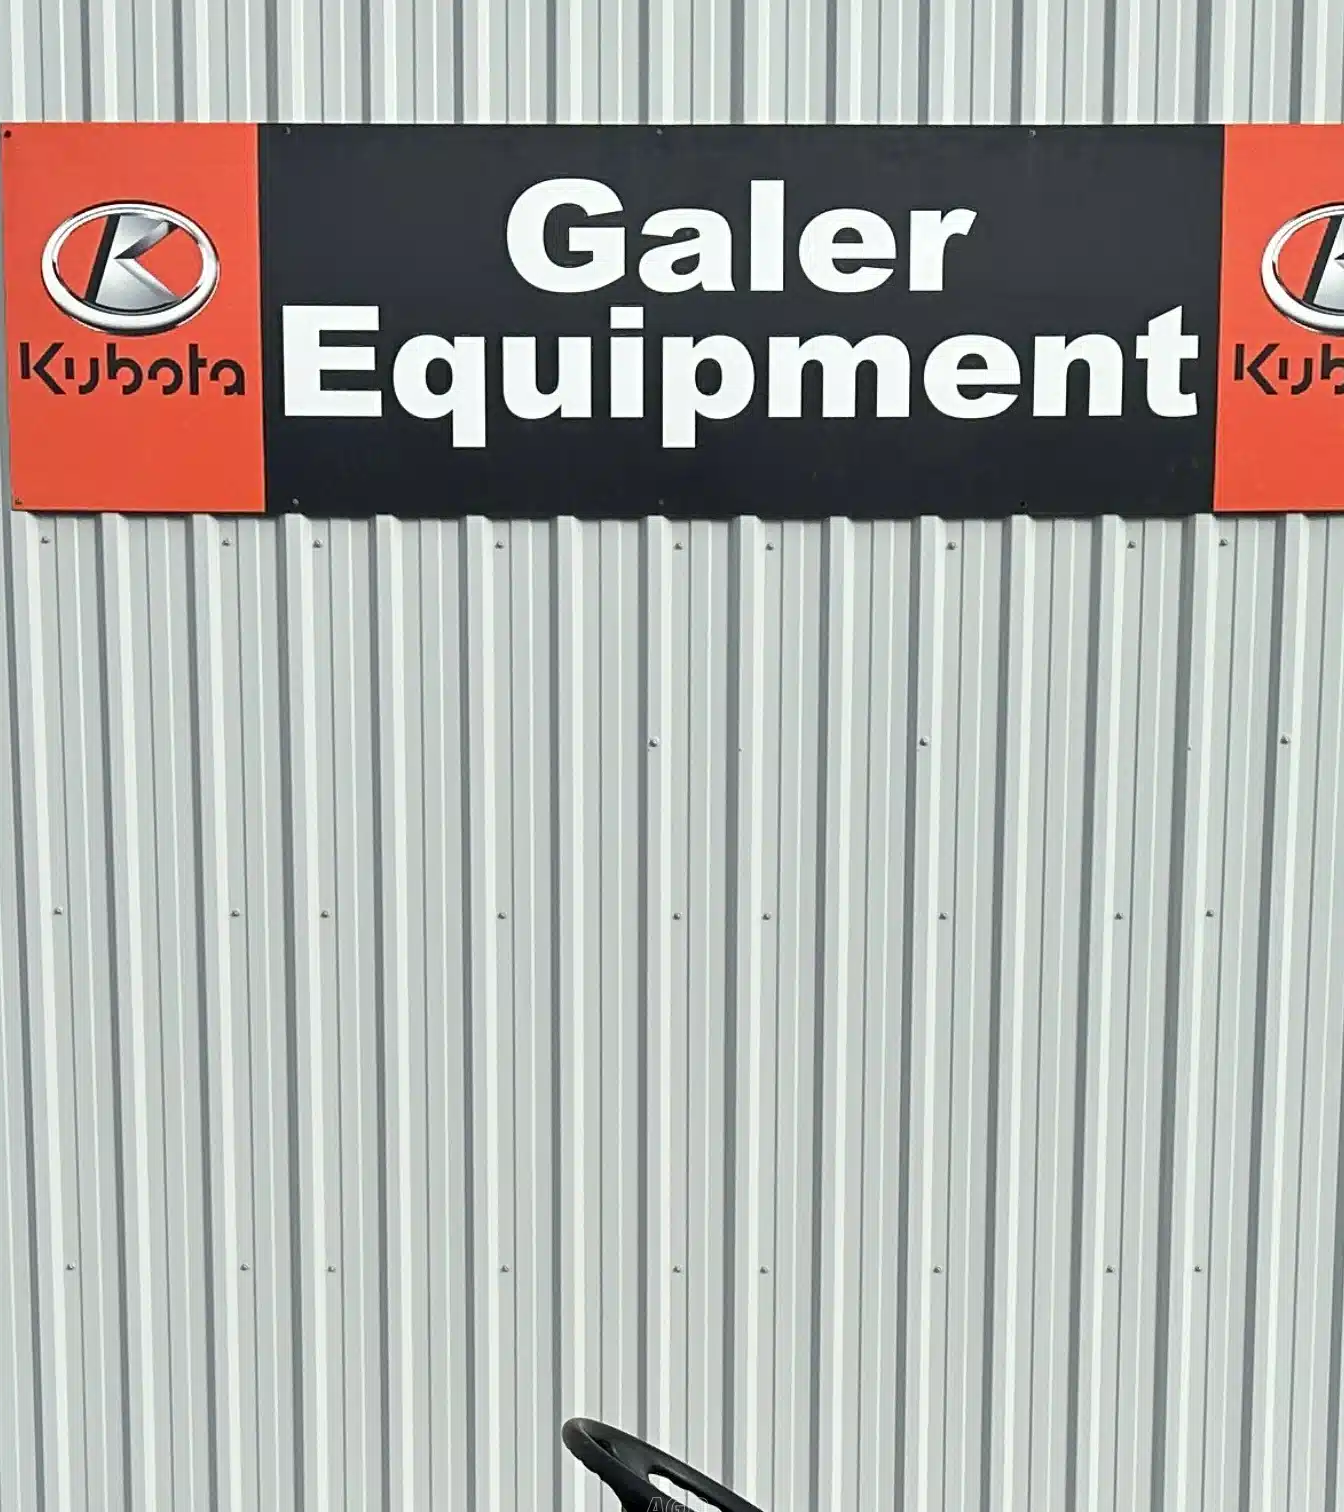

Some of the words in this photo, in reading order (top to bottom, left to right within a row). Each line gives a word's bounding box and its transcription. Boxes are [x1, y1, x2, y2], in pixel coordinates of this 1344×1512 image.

[506, 177, 977, 293] Galer
[20, 342, 245, 396] Kubota
[282, 305, 1199, 448] Equipment
